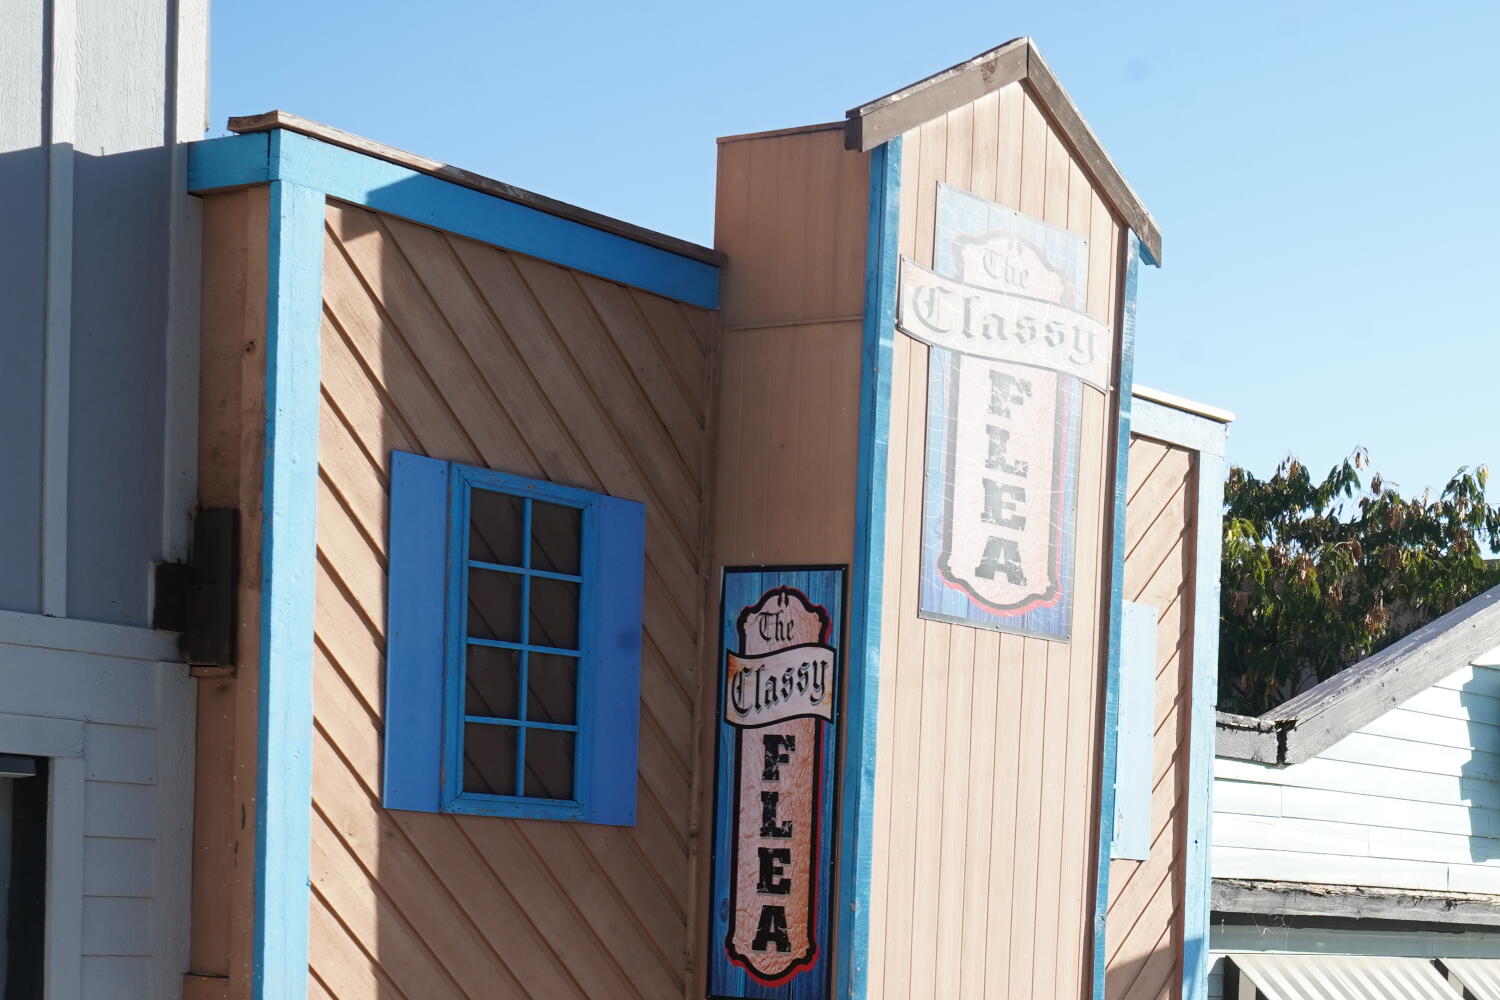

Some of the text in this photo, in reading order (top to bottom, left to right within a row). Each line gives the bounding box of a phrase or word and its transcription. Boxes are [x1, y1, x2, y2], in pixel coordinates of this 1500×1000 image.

[980, 247, 1030, 290] The
[911, 285, 1100, 368] Classy
[974, 369, 1032, 587] FLEA
[756, 611, 796, 642] The
[731, 658, 829, 717] Classy
[751, 734, 796, 954] FLEA
